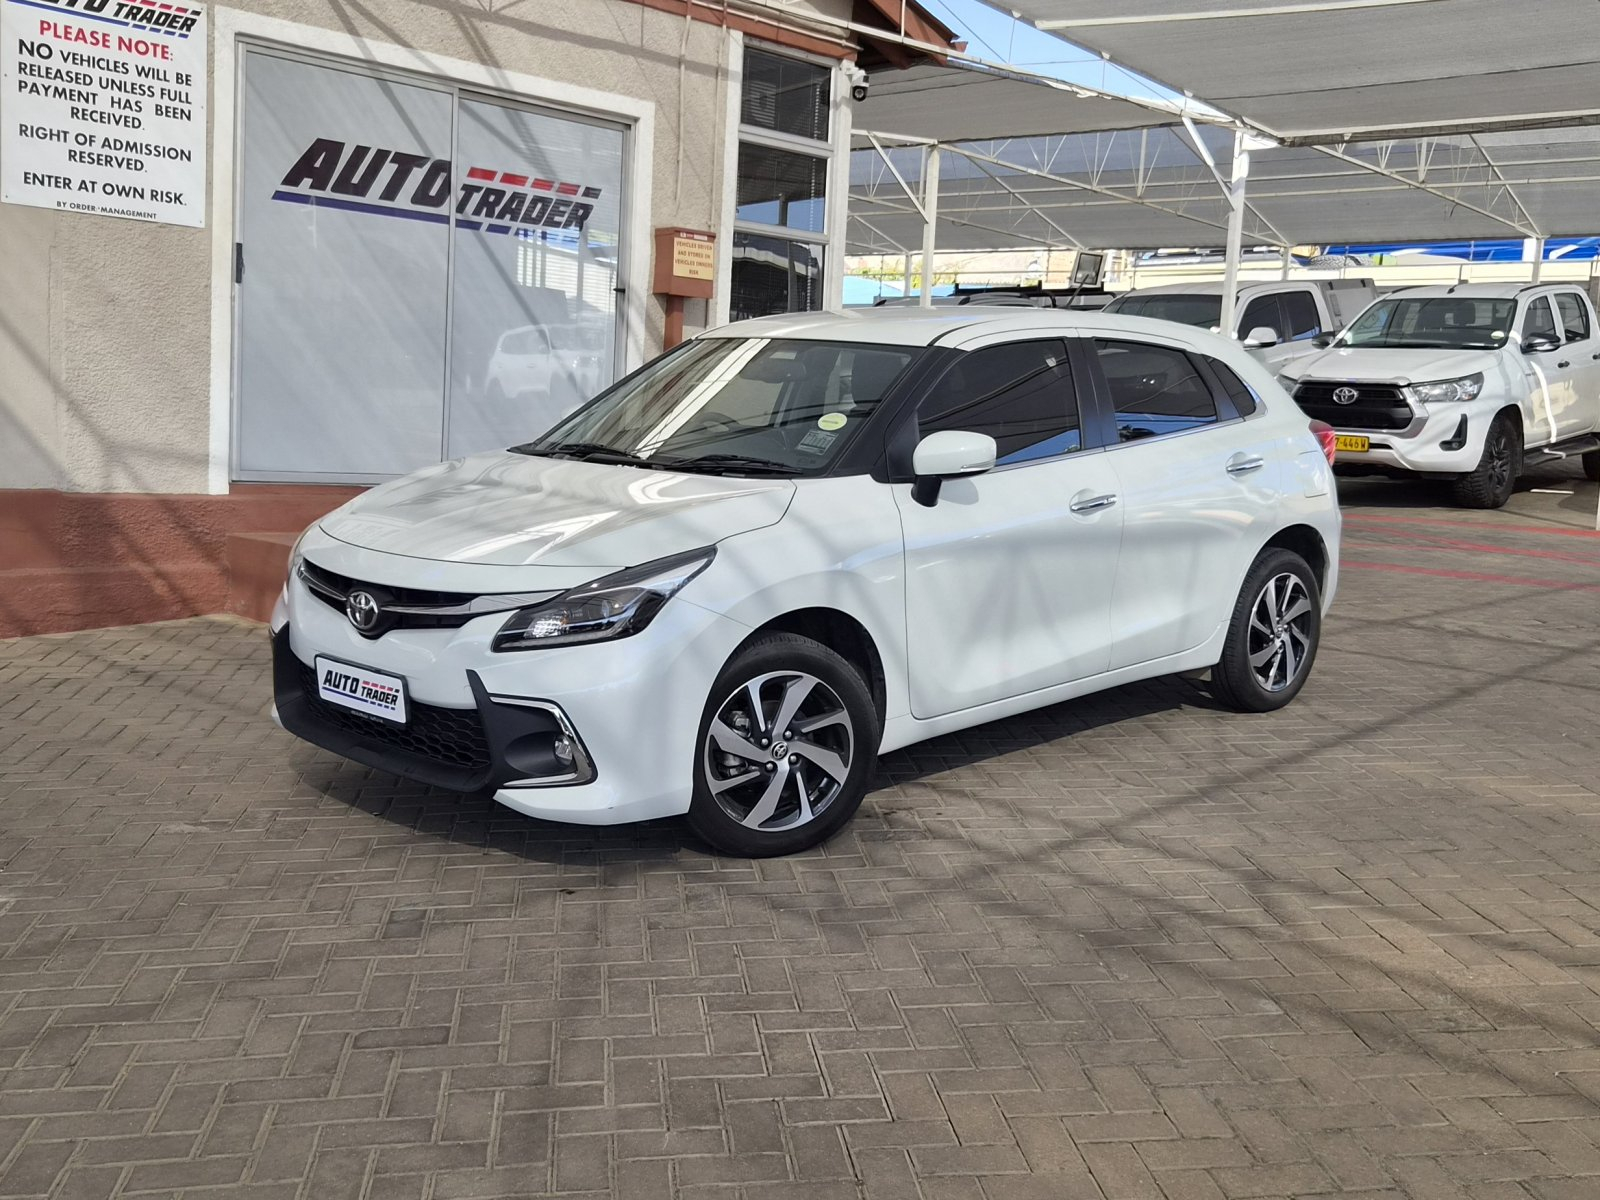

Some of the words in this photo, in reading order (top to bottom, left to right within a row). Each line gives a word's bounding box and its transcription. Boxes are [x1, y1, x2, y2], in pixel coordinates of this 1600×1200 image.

[113, 3, 197, 32] TRADER
[40, 20, 110, 48] PLEASE
[118, 36, 174, 60] NOTE:
[19, 39, 53, 60] NO
[60, 50, 129, 75] VEHICLES
[135, 65, 170, 83] WILL
[176, 73, 192, 86] BE
[18, 62, 93, 87] RELEASED
[99, 77, 155, 98] UNLESS
[161, 88, 192, 104] FULL
[18, 80, 98, 105] PAYMENT
[111, 96, 143, 113] HAS
[155, 104, 192, 121] BEEN
[71, 106, 145, 130] RECEIVED.
[19, 124, 69, 143] RIGHT
[75, 133, 96, 147] OF
[101, 137, 192, 162] ADMISSION
[68, 150, 148, 173] RESERVED.
[23, 171, 72, 190] ENTER
[78, 180, 97, 193] AT
[102, 183, 145, 199] OWN
[150, 189, 187, 206] RISK.
[281, 138, 452, 208] AUTO
[455, 184, 594, 231] TRADER
[69, 202, 96, 211] ORDER
[323, 669, 360, 695] AUTO
[361, 686, 398, 706] TRADER
